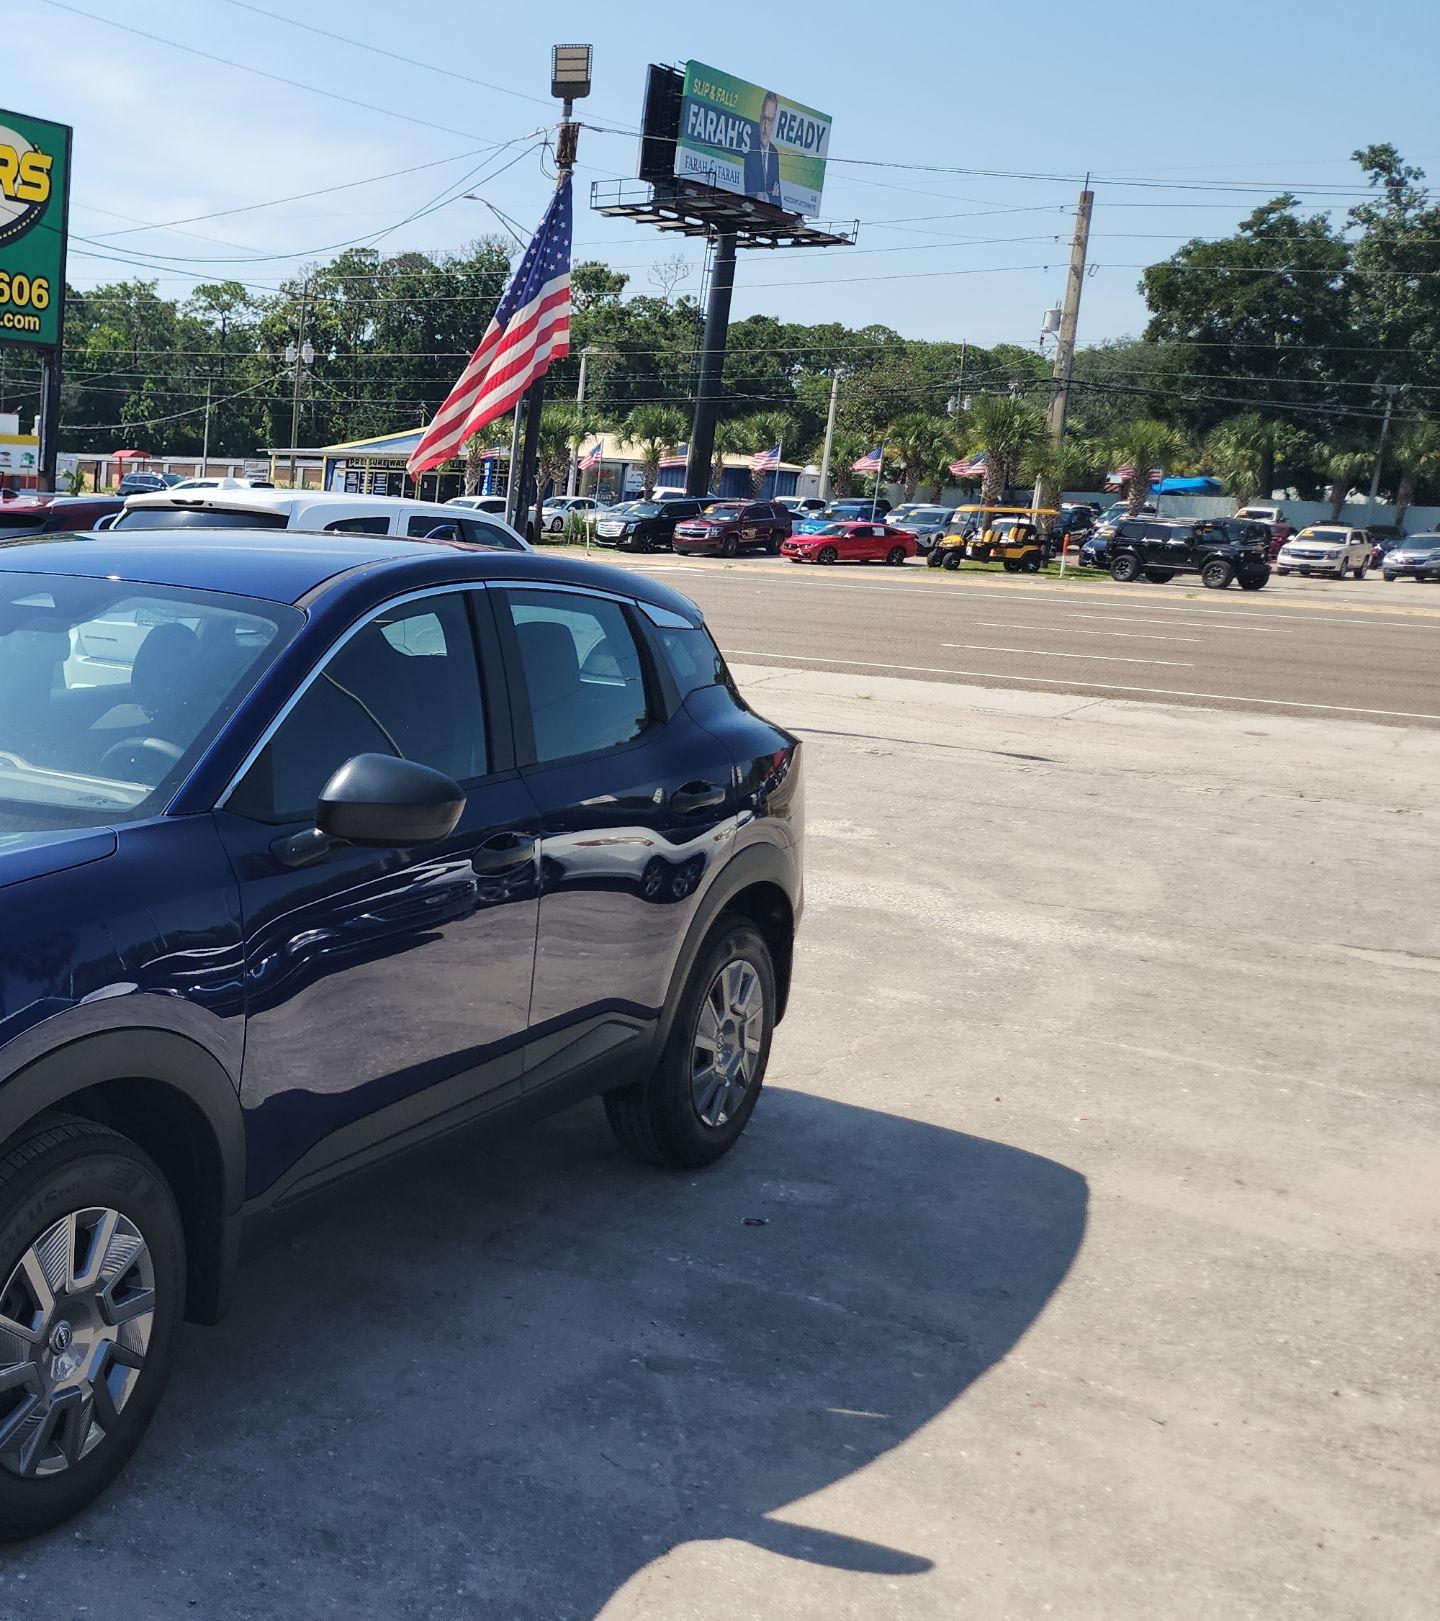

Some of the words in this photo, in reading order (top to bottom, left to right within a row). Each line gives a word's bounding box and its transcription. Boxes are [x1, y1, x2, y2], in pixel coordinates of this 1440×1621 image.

[687, 103, 752, 154] FARAH'S
[776, 110, 826, 152] READY
[685, 155, 708, 174] FARAH
[717, 165, 740, 184] FARAH
[348, 457, 388, 468] PRESURE
